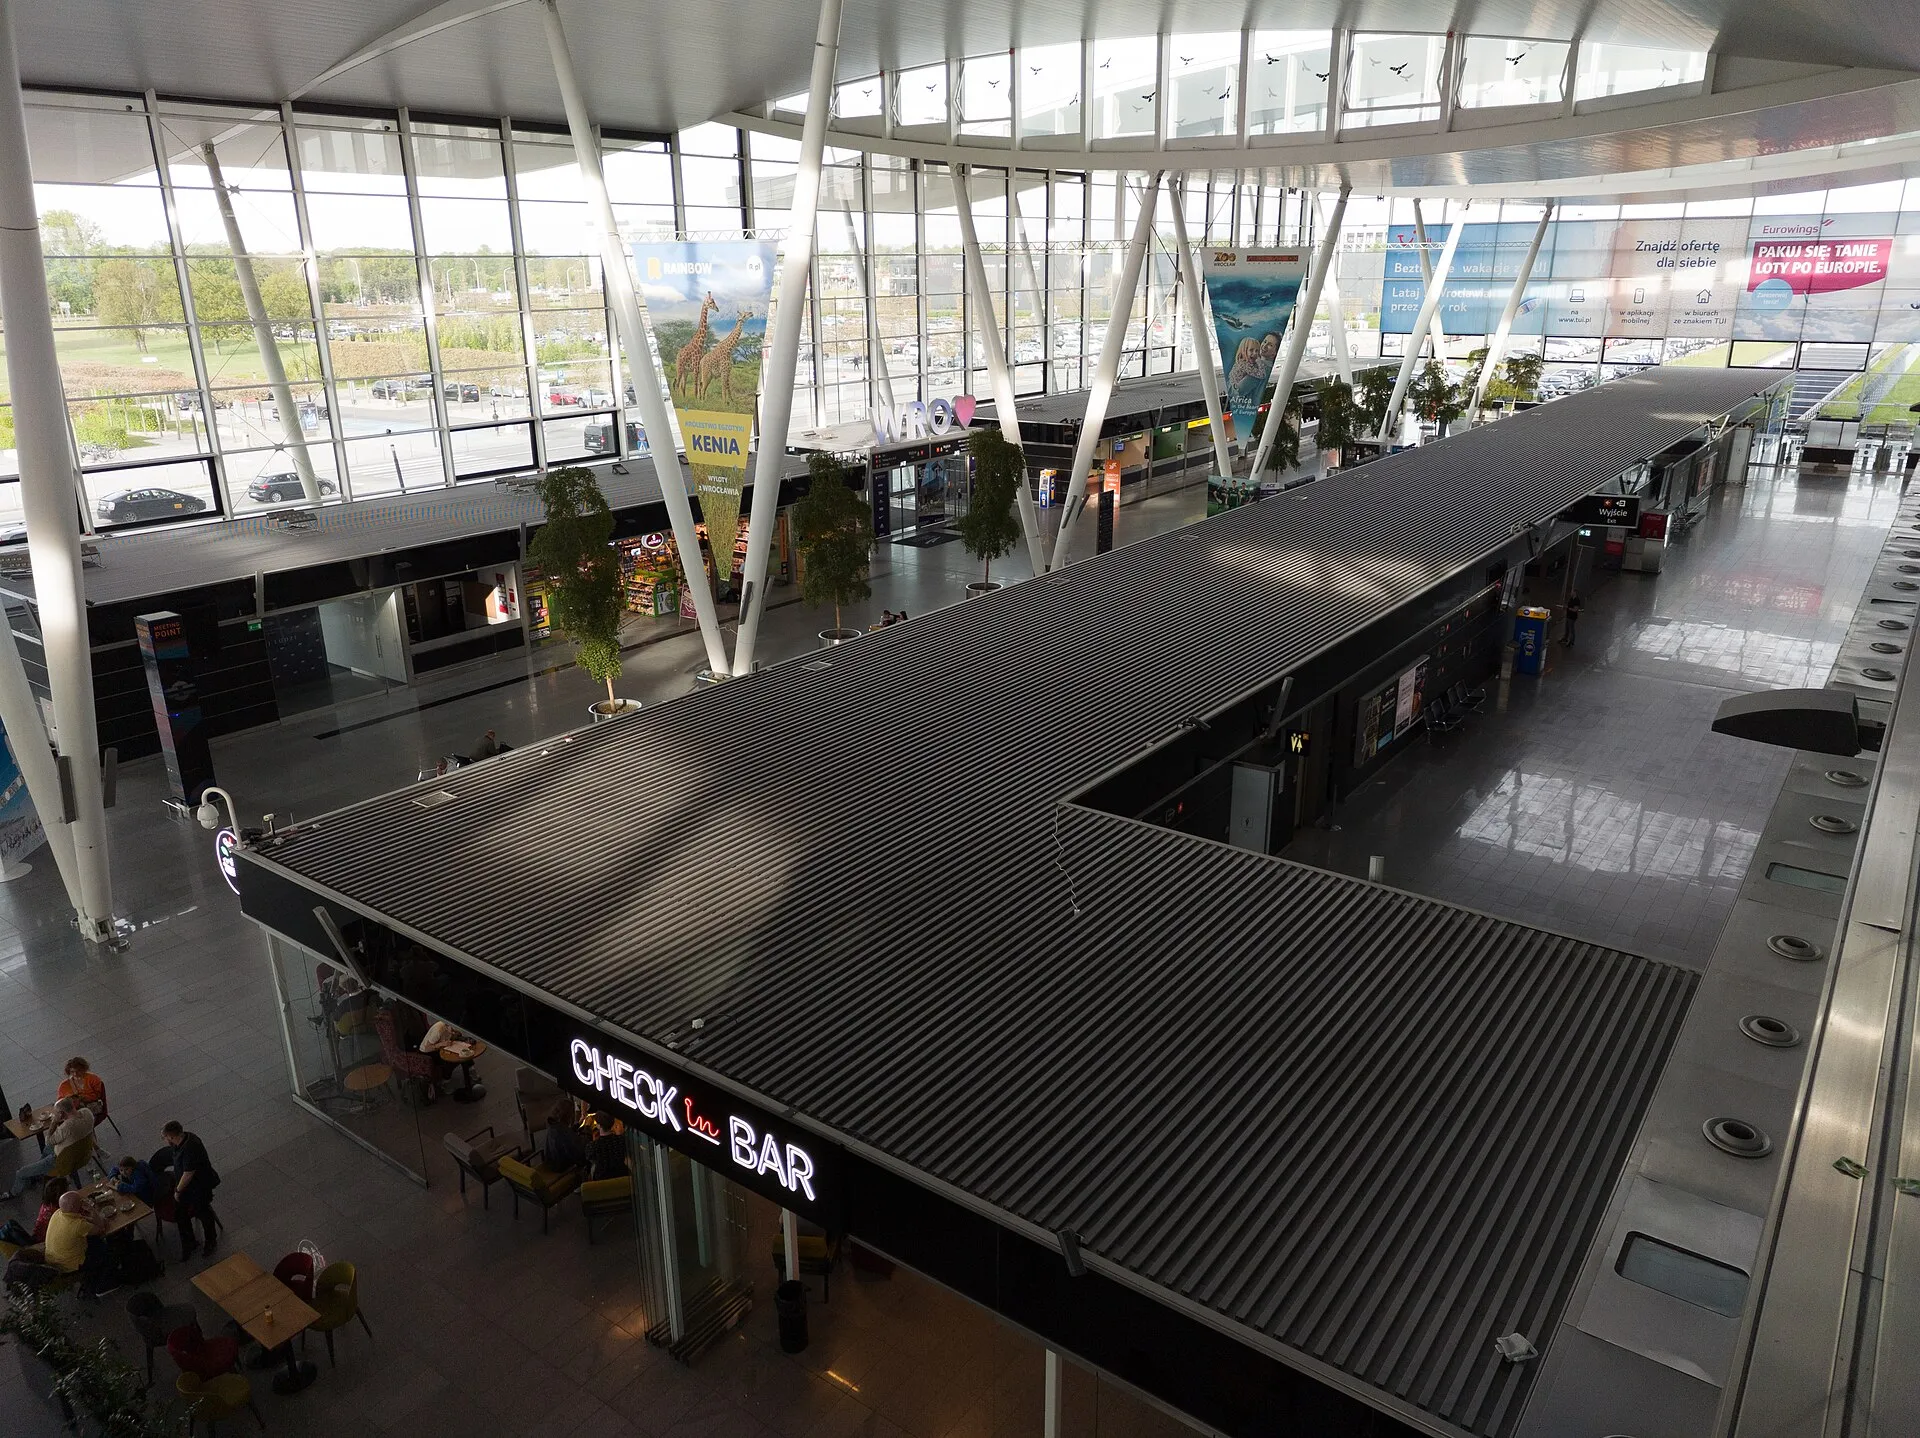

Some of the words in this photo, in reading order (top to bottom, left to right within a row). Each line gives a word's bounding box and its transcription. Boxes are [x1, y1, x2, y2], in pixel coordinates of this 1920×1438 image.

[1762, 225, 1819, 235] Eurowings
[1635, 240, 1676, 254] Znajdź
[1681, 240, 1720, 254] ofertę
[1758, 246, 1802, 258] PAKUJ
[1804, 245, 1832, 260] SIĘ:
[1835, 244, 1879, 257] TANIE
[1214, 252, 1236, 262] ZOO
[1656, 257, 1674, 268] dla
[1679, 257, 1716, 268] siebie
[663, 262, 712, 274] RAINBOW
[1394, 262, 1454, 272] Beztse
[1462, 262, 1510, 276] wakacje
[1756, 262, 1790, 274] LOTY
[1791, 262, 1812, 274] PO
[1815, 261, 1882, 274] EUROPIE.
[1392, 287, 1420, 300] Lataj
[1391, 303, 1419, 313] przez
[1448, 302, 1468, 312] rok
[1230, 396, 1252, 404] Africa
[868, 398, 952, 444] WRO
[692, 434, 740, 455] KENIA
[708, 475, 728, 483] WYLOTY
[702, 484, 739, 496] WROCŁAWIA
[1599, 508, 1628, 517] Wyjście
[154, 622, 180, 630] MEETING
[155, 628, 181, 638] POINT
[570, 1038, 682, 1132] CHECK
[684, 1098, 719, 1137] in
[729, 1115, 816, 1202] BAR
